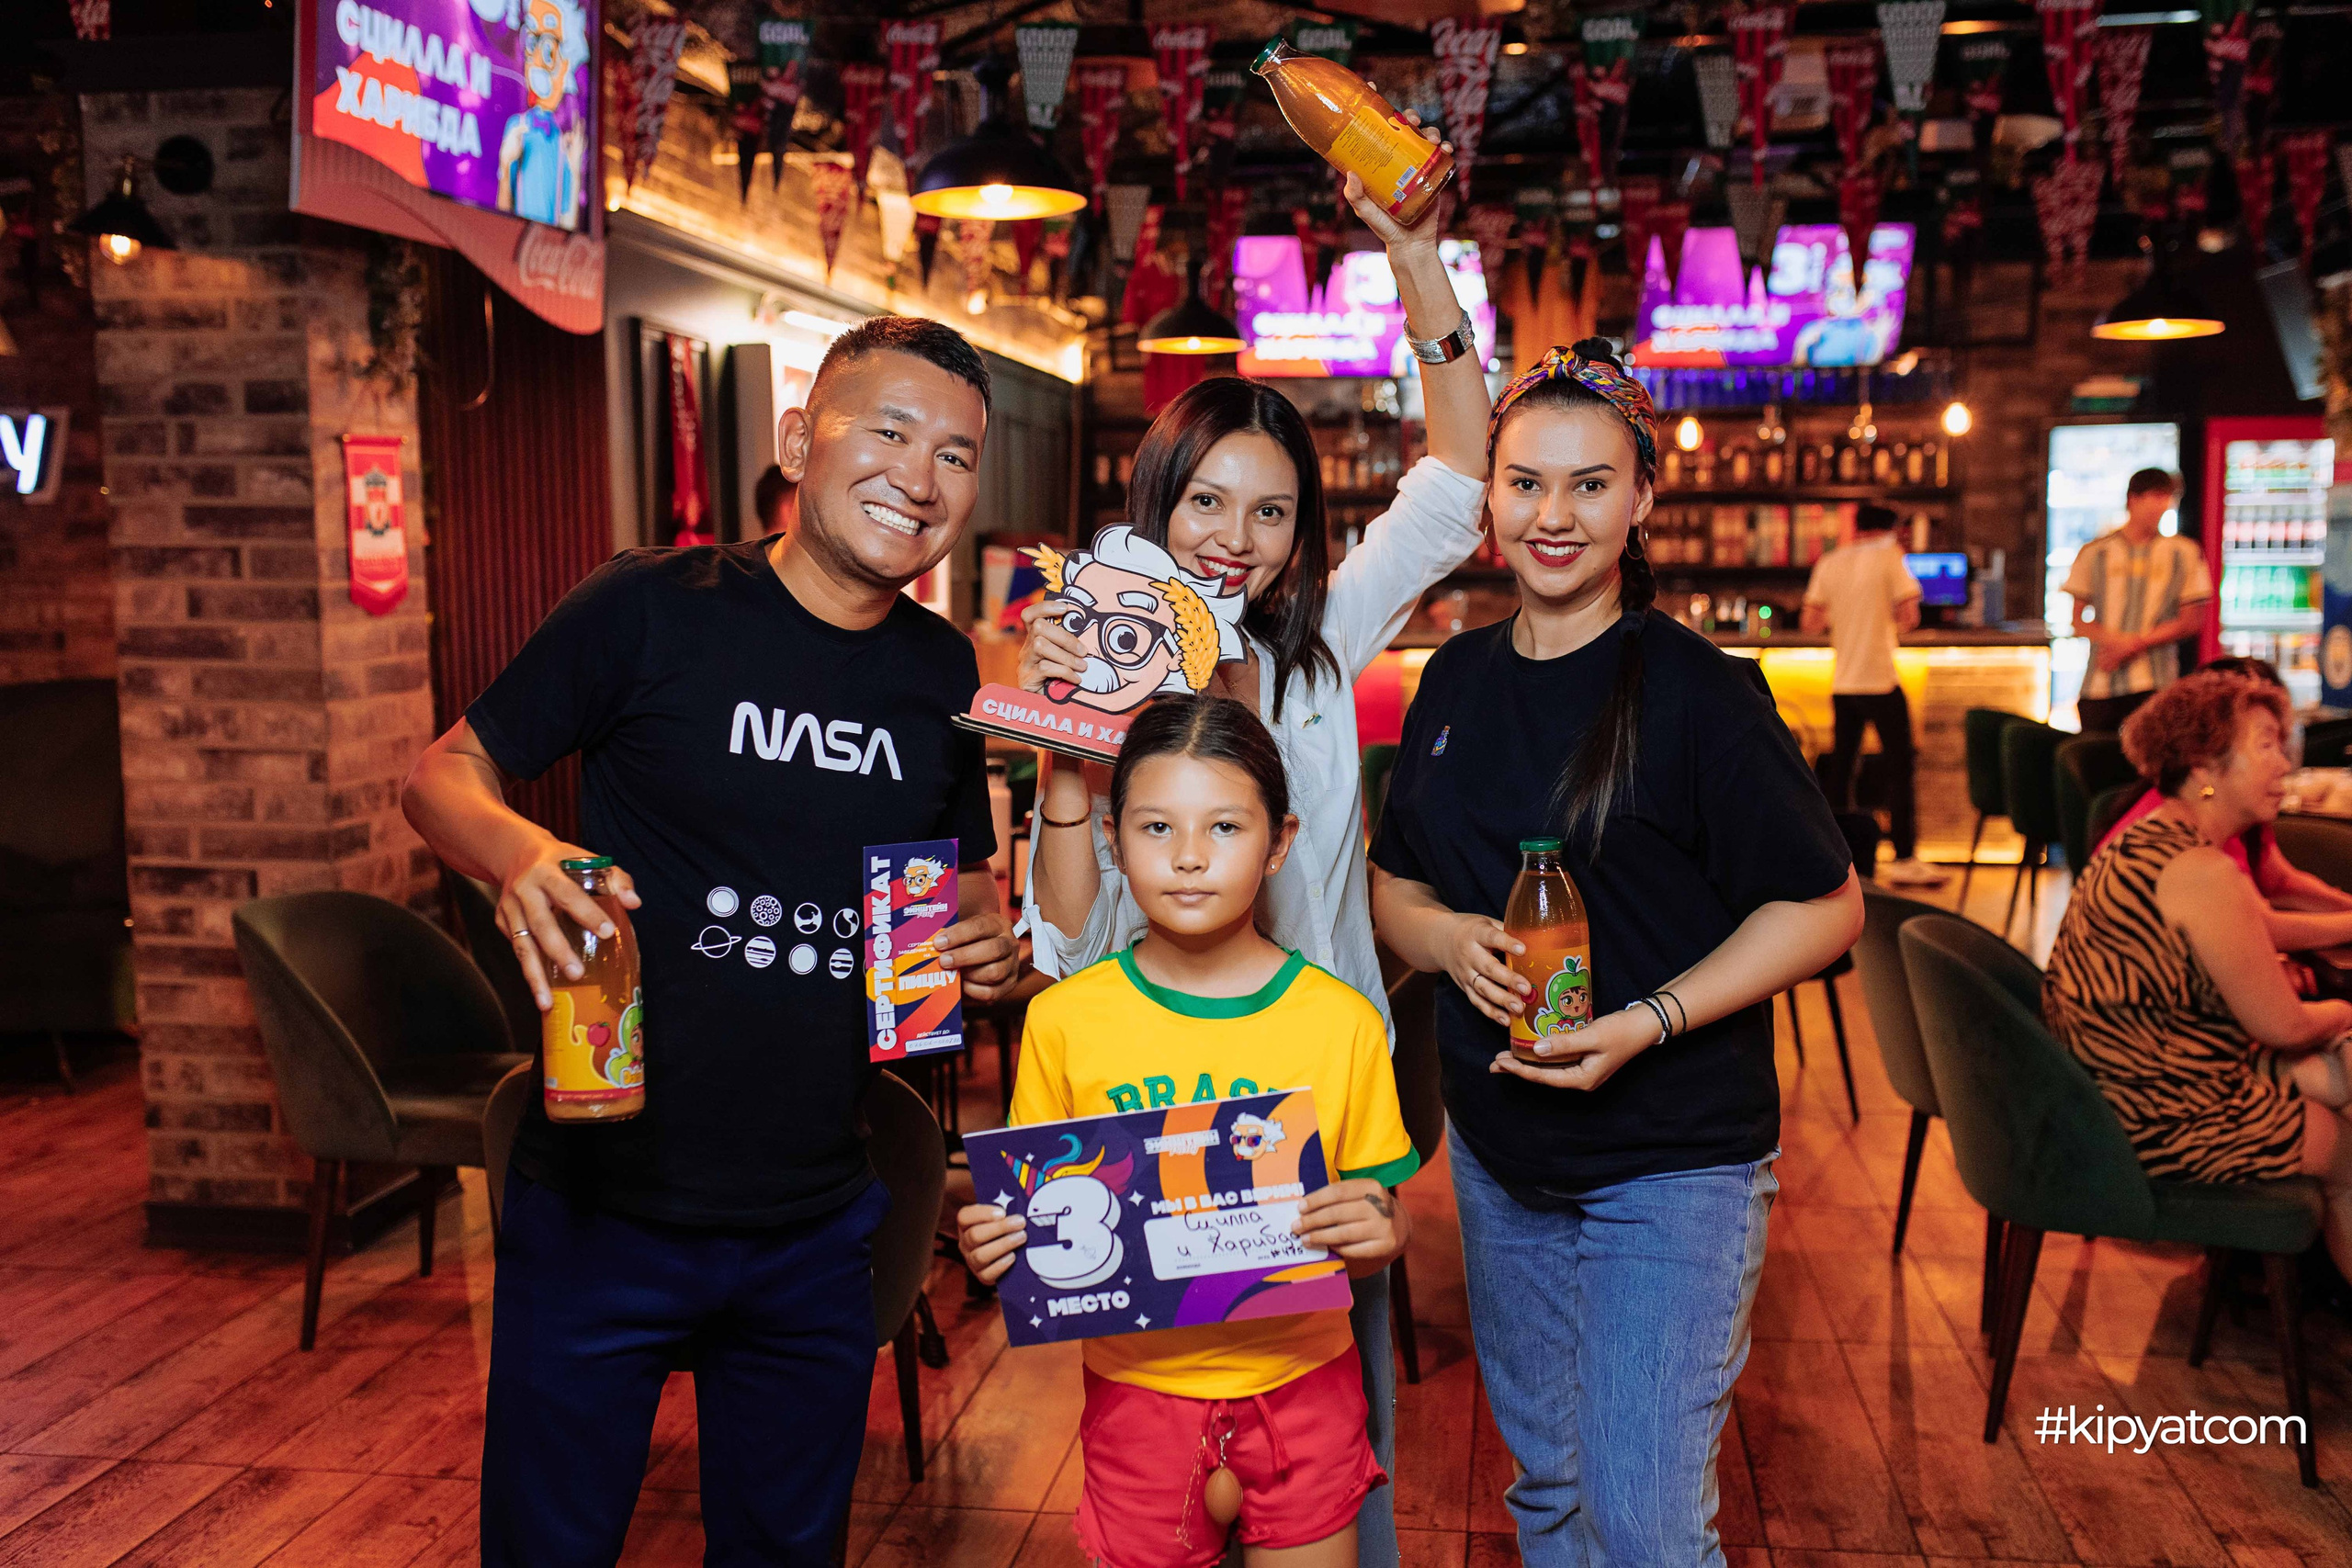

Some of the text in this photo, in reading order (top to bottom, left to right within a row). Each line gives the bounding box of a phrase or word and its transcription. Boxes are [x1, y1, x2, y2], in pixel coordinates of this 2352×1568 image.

[335, 0, 469, 90] СЦИЛЛА
[469, 51, 492, 100] И
[335, 66, 483, 159] ХАРИБДА
[729, 701, 903, 781] NASA
[982, 698, 1127, 745] СЦИЛЛА И ХА
[871, 855, 897, 1051] СЕРТИФИКАТ
[899, 970, 958, 991] ПИЦЦУ
[1106, 1073, 1280, 1113] BRA
[1025, 1174, 1124, 1290] 3
[1150, 1196, 1182, 1215] МЫ
[1046, 1290, 1130, 1317] МЕСТО
